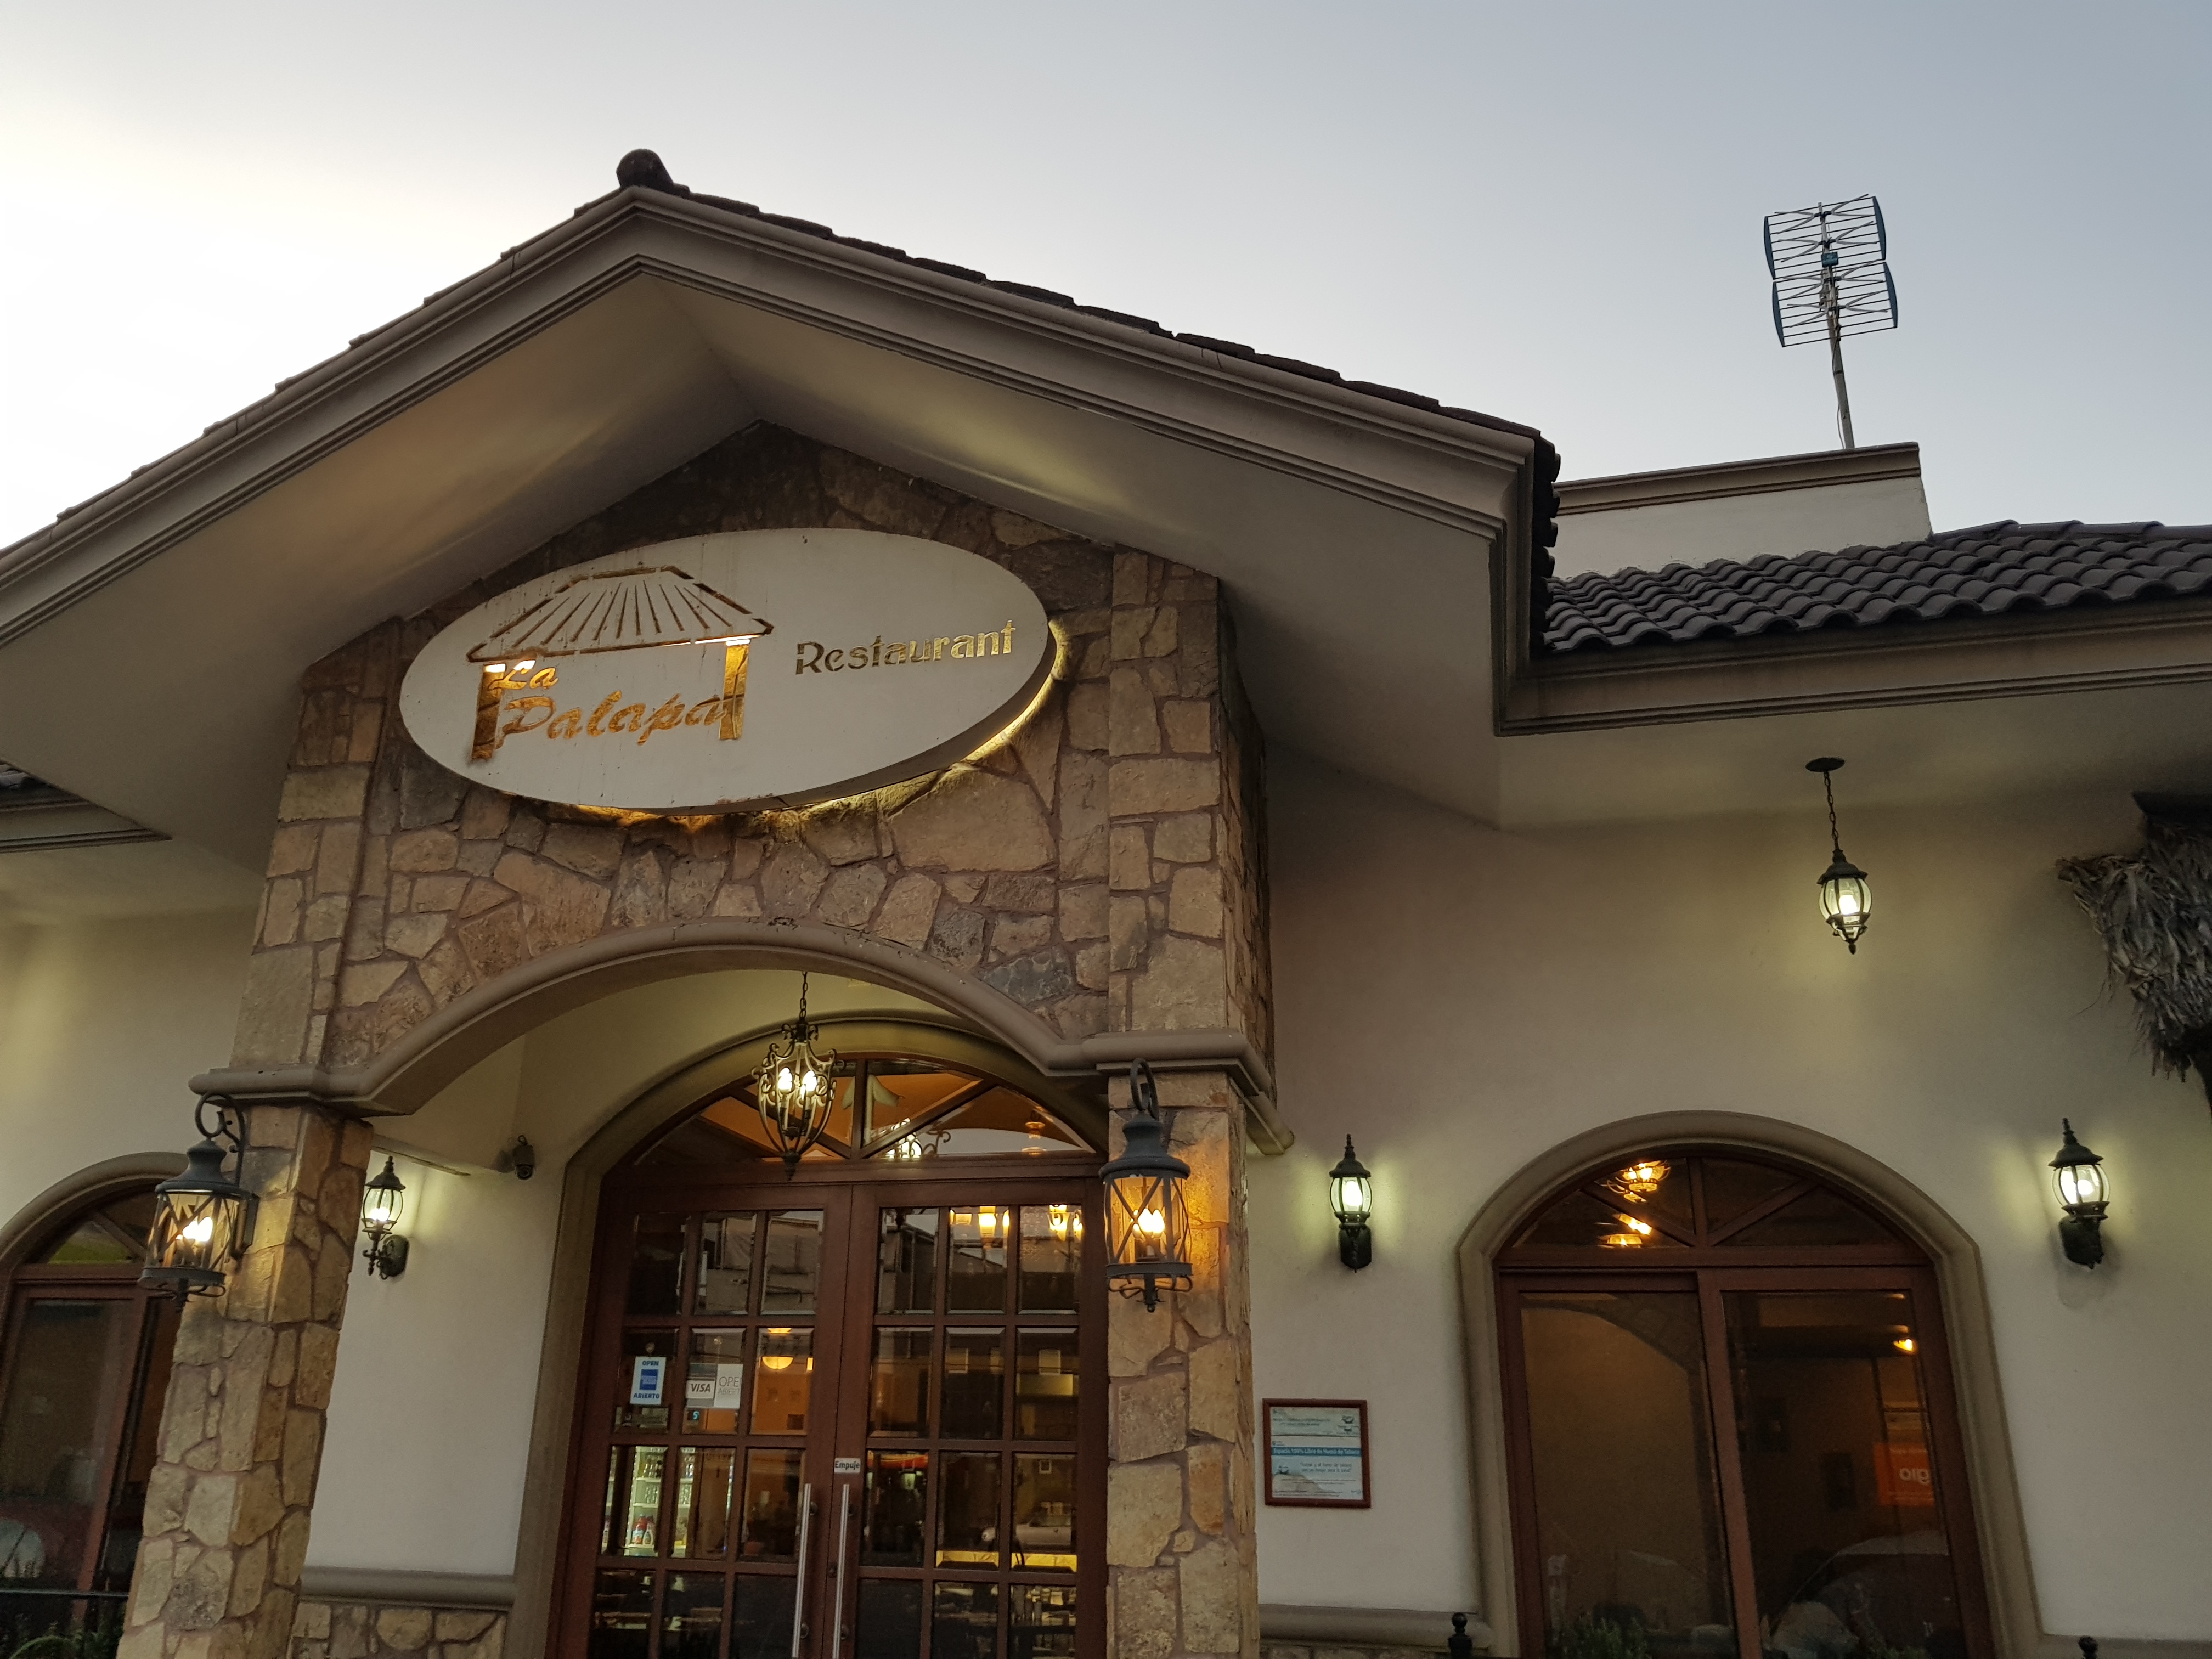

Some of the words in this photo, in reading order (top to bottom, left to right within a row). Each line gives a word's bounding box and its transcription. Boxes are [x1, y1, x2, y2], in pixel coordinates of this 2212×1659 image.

[795, 619, 1016, 675] Restaurant
[487, 659, 559, 690] La
[495, 690, 727, 749] Palapa
[690, 1383, 711, 1392] VISA
[719, 1376, 742, 1387] OPE
[835, 1461, 860, 1470] Empuje
